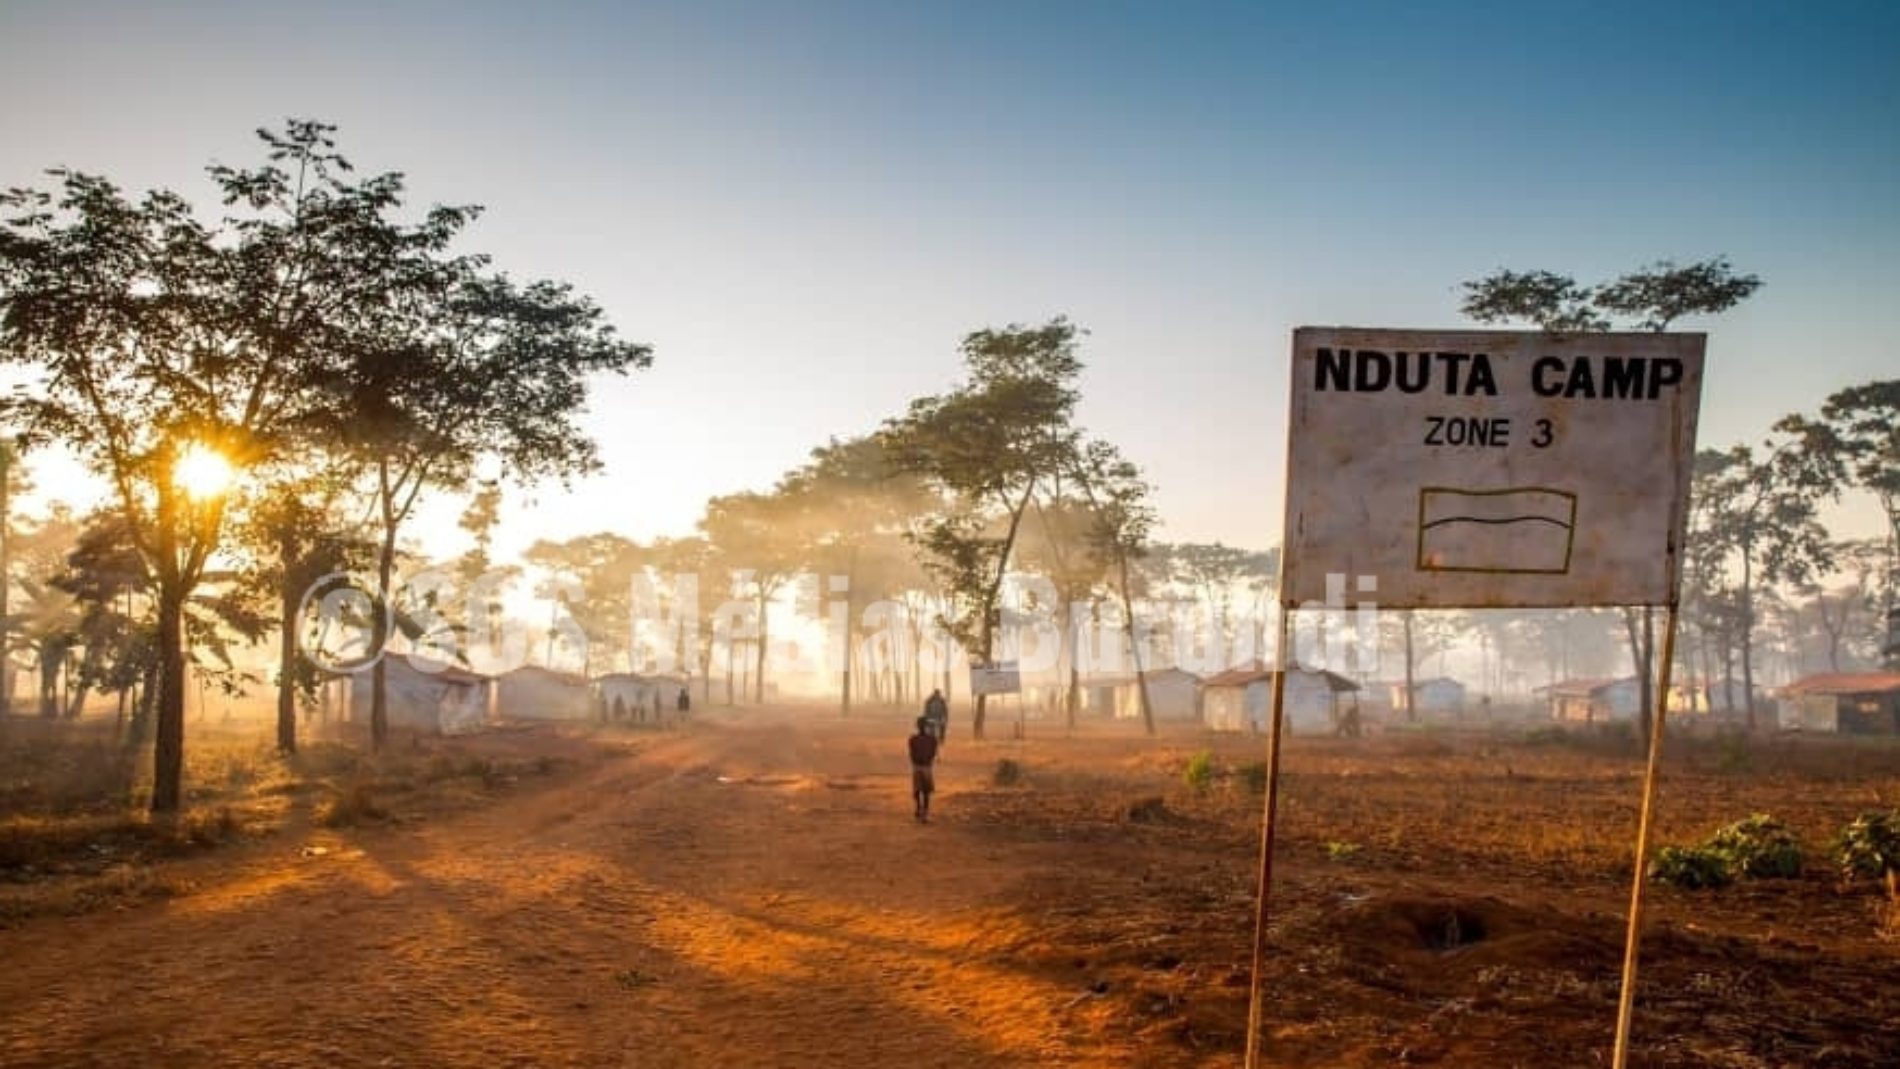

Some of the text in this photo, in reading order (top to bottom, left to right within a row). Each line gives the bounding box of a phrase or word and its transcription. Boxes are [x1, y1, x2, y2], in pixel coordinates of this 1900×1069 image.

[1314, 347, 1684, 400] NDUTA CAMP
[1424, 416, 1554, 448] ZONE 3
